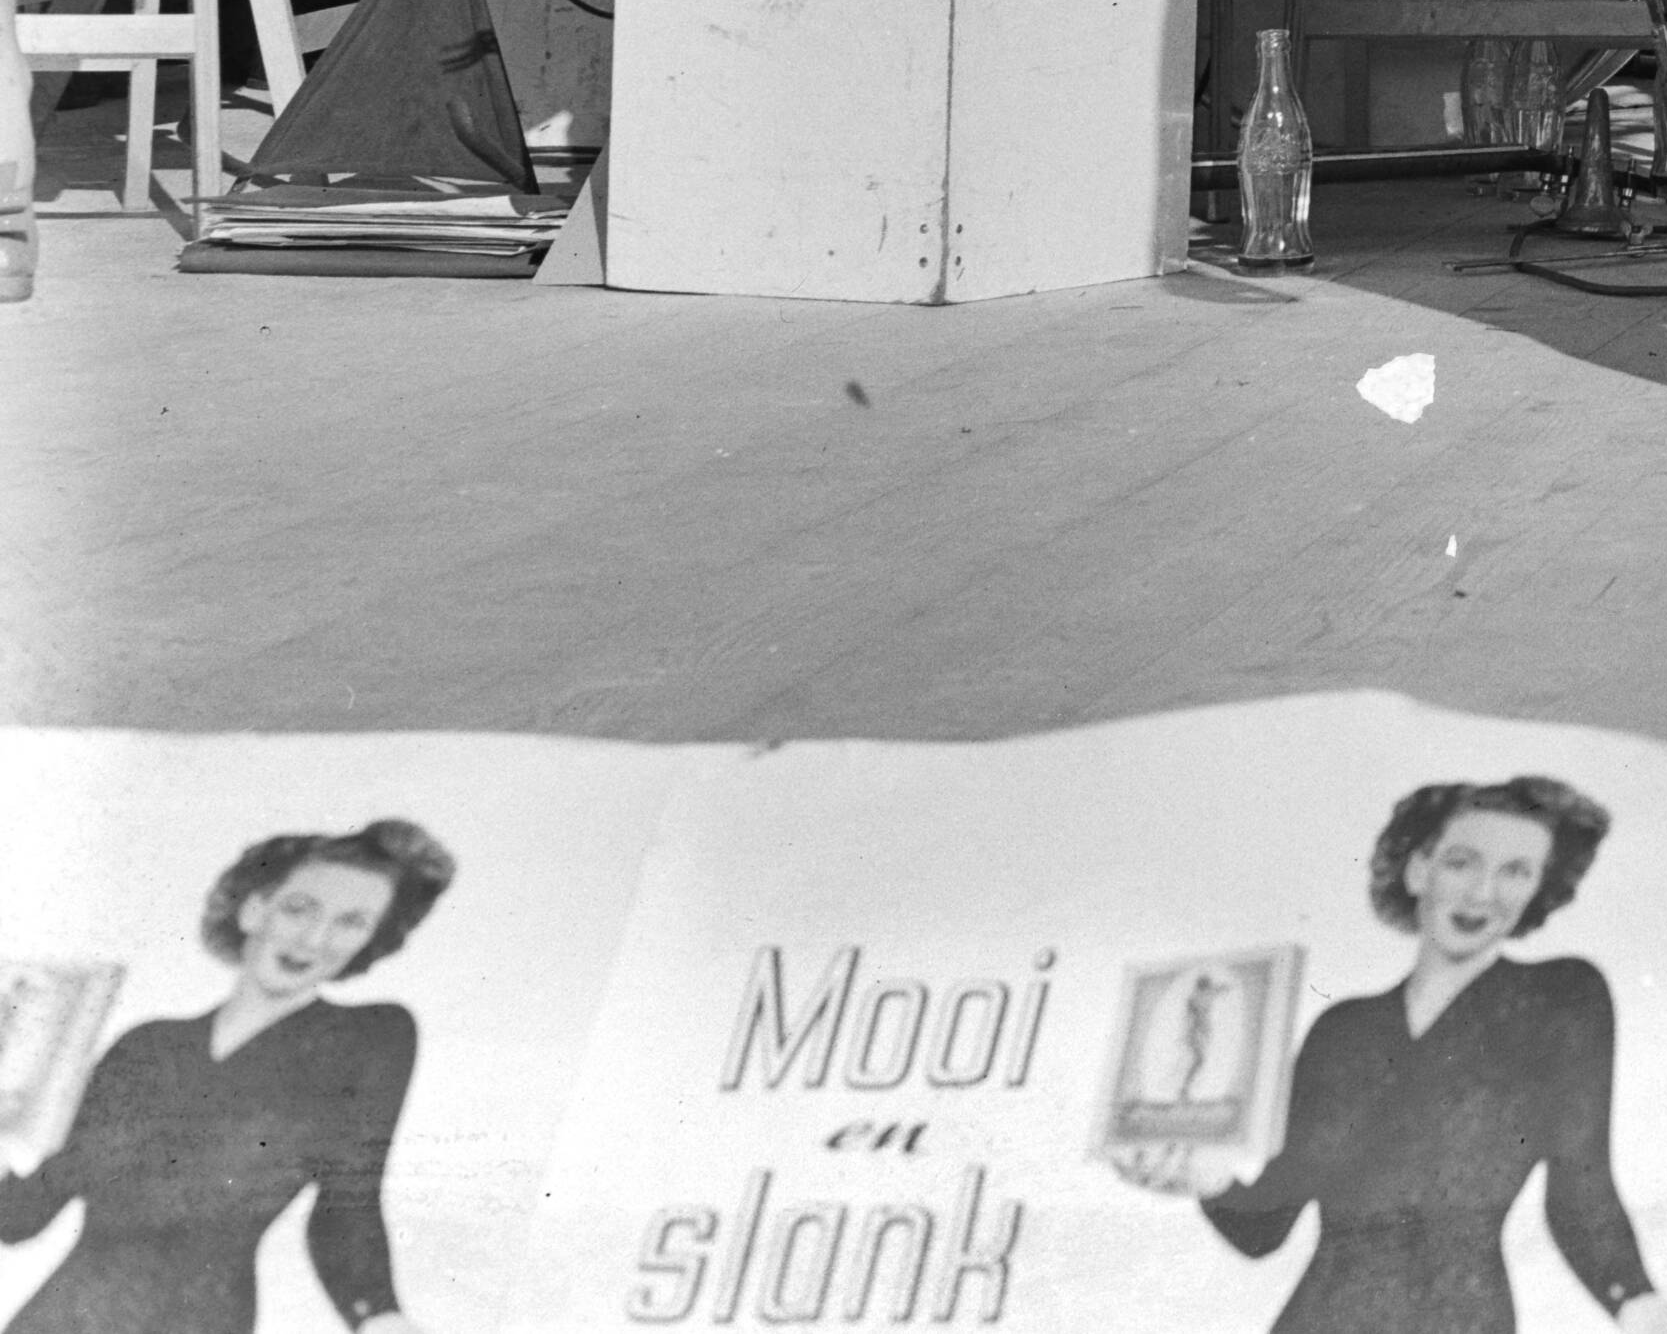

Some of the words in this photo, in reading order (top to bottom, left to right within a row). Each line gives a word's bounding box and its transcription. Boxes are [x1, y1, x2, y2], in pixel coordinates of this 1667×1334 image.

[717, 944, 1057, 1092] Mooi
[826, 1121, 928, 1155] en
[625, 1163, 1024, 1325] slank
